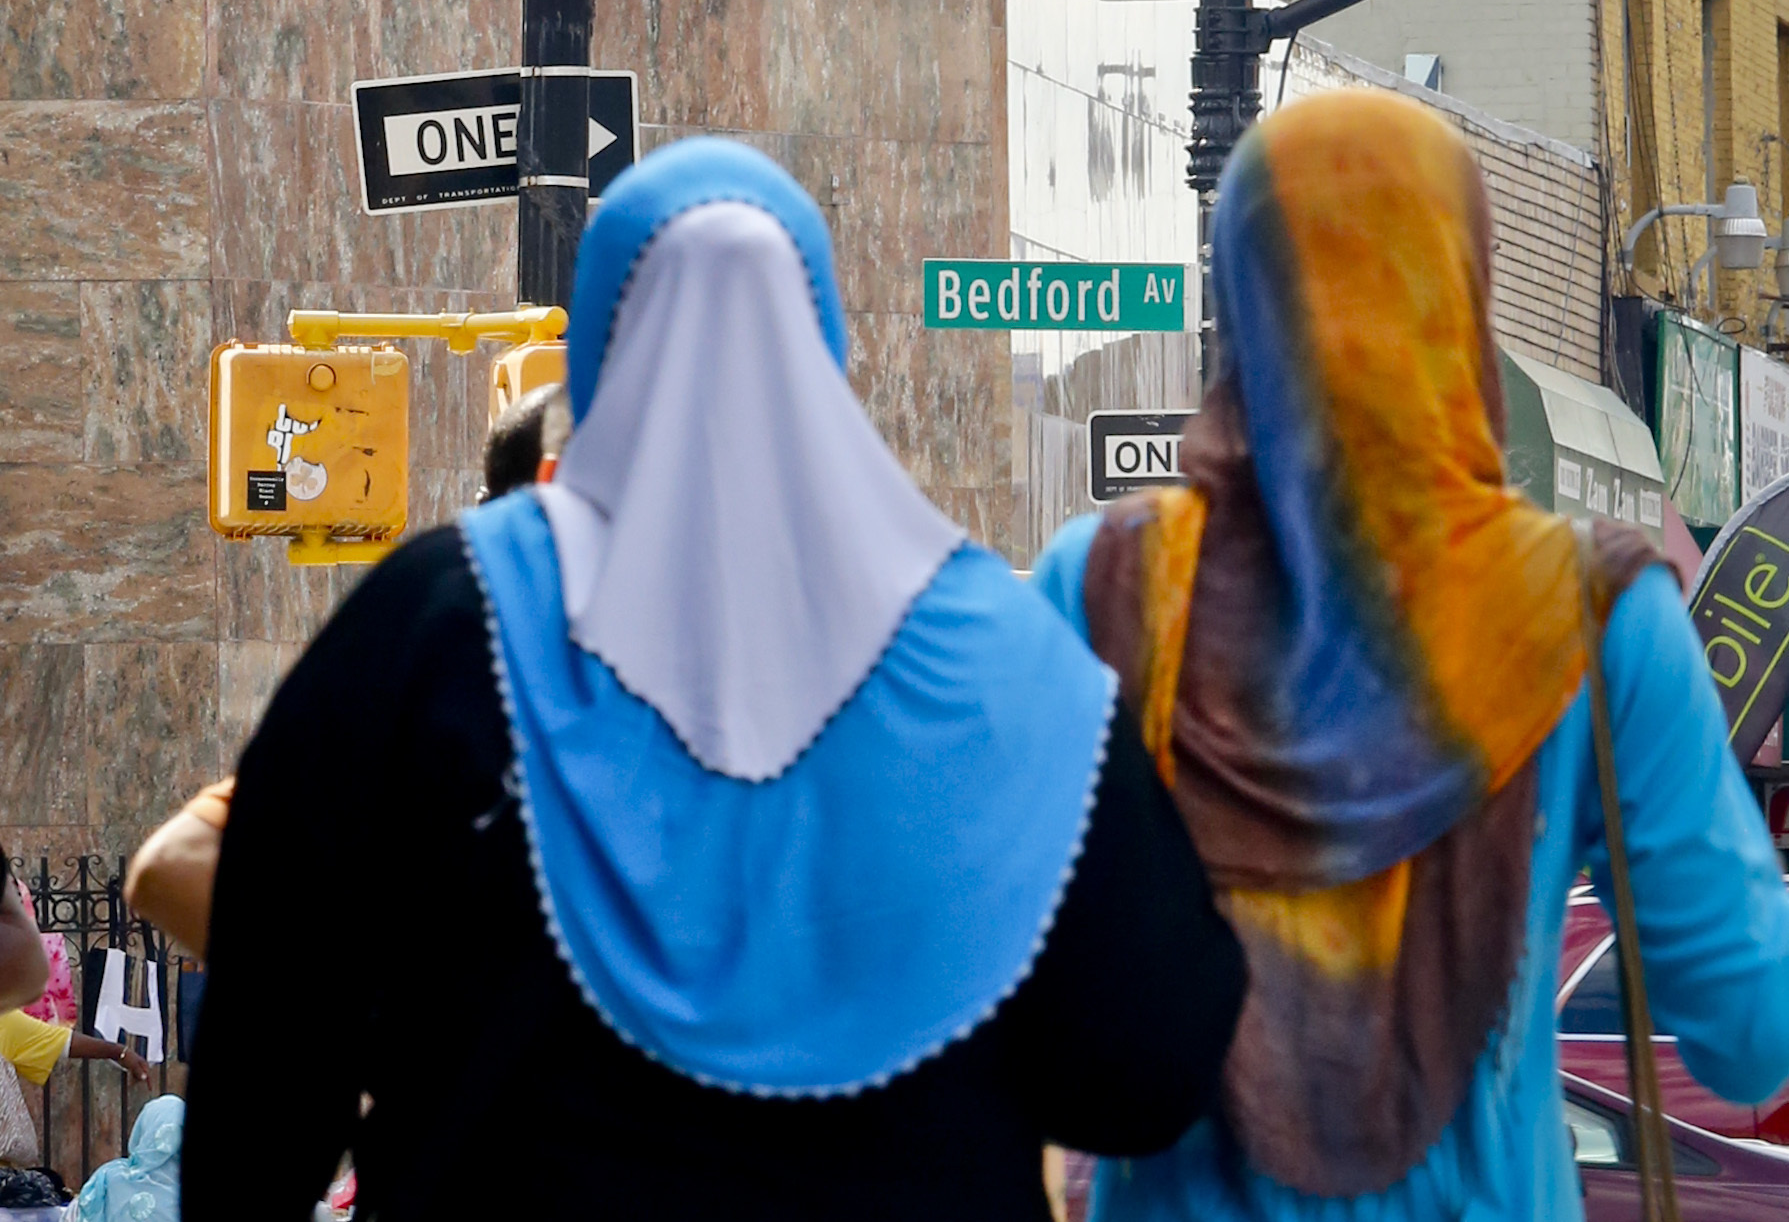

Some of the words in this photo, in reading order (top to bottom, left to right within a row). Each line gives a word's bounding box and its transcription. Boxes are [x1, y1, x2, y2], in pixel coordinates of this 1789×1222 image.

[417, 112, 517, 166] ONE
[382, 195, 406, 205] DEPT
[416, 193, 429, 201] OF
[438, 185, 519, 199] TRANSPORTATIO
[937, 267, 1121, 322] Bedford
[1143, 273, 1176, 304] Av
[1115, 440, 1181, 474] ON
